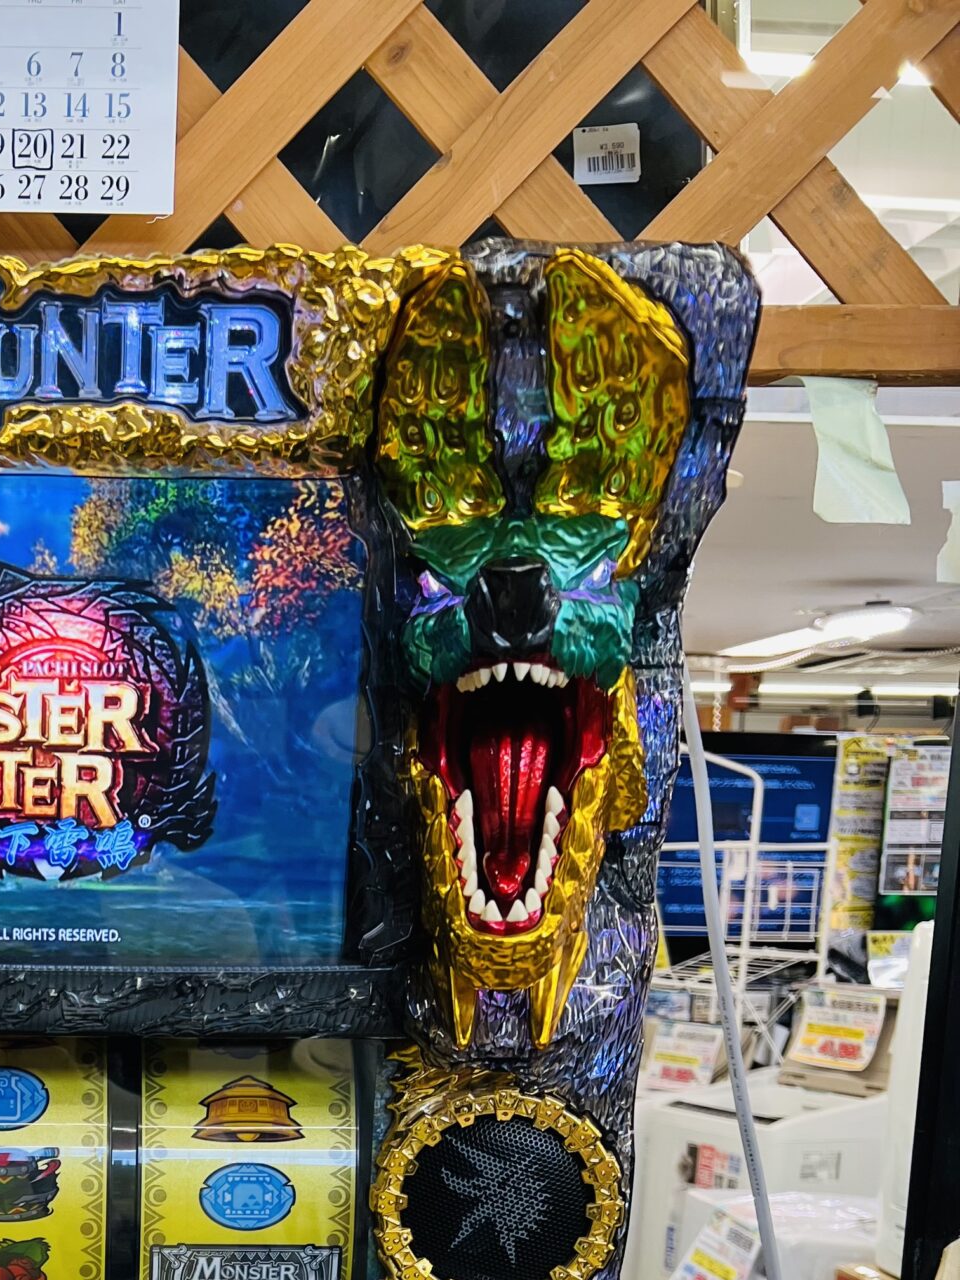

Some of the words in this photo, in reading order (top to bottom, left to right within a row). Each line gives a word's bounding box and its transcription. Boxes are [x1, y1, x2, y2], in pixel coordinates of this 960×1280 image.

[115, 11, 123, 37] 1
[27, 51, 41, 77] 6
[70, 52, 84, 77] 7
[111, 52, 125, 78] 8
[21, 92, 47, 118] 13
[64, 92, 90, 118] 14
[105, 93, 131, 119] 15
[17, 133, 48, 159] 20
[60, 133, 86, 160] 21
[101, 134, 130, 160] 22
[17, 175, 46, 200] 27
[59, 175, 88, 200] 28
[100, 176, 129, 201] 29
[21, 660, 127, 678] PACHISLOT
[13, 928, 55, 941] RIGHTS
[58, 929, 121, 942] RESERVED.
